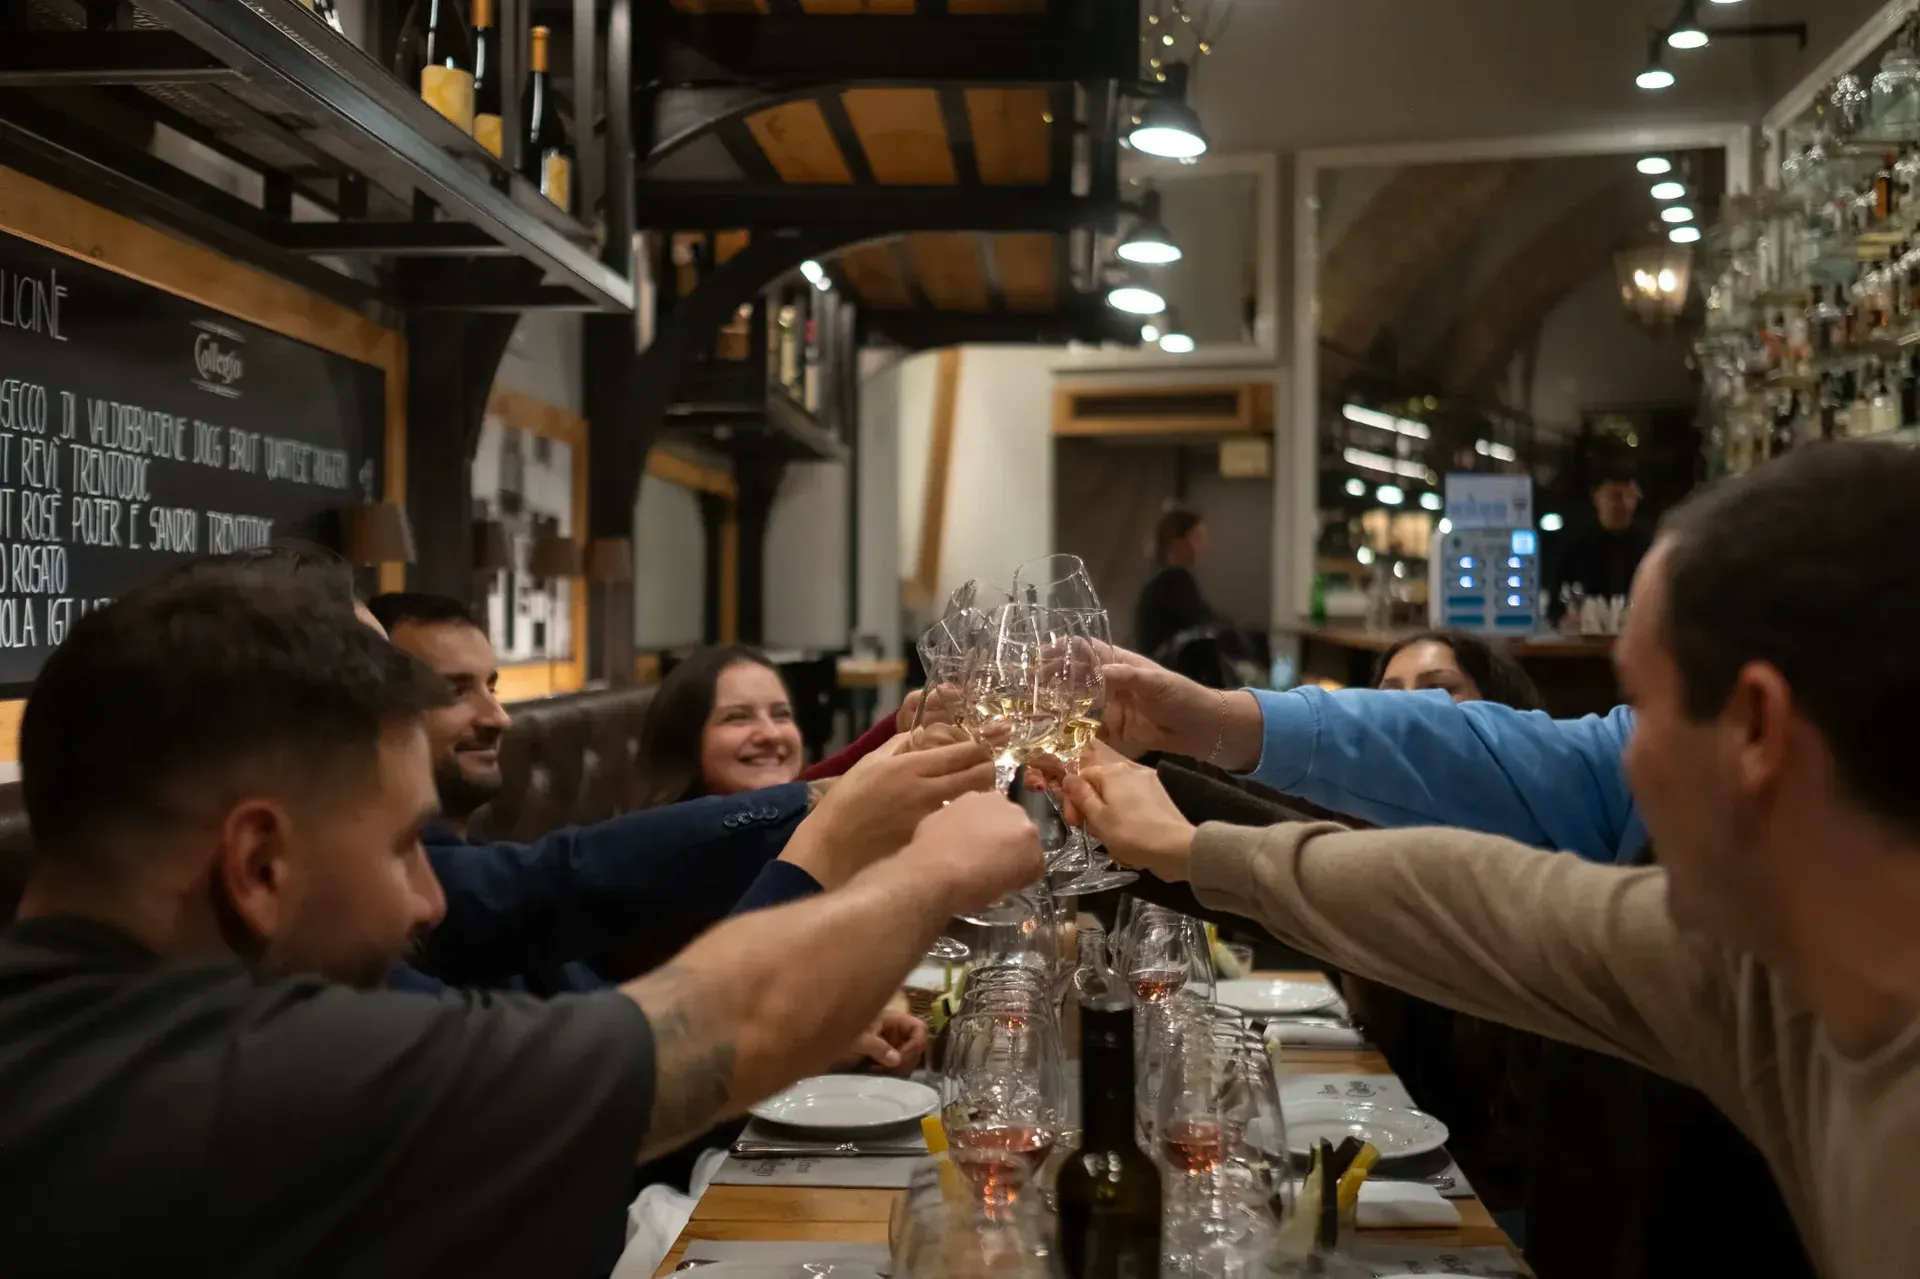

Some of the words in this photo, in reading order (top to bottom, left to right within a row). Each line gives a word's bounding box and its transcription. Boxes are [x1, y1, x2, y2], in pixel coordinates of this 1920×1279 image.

[0, 268, 68, 341] LICINE
[194, 332, 244, 384] Collegio
[0, 379, 48, 434] SECCO
[60, 391, 76, 439] DI
[228, 427, 260, 474] BRUT
[12, 543, 68, 593] ROSATO
[0, 598, 36, 648] OLA
